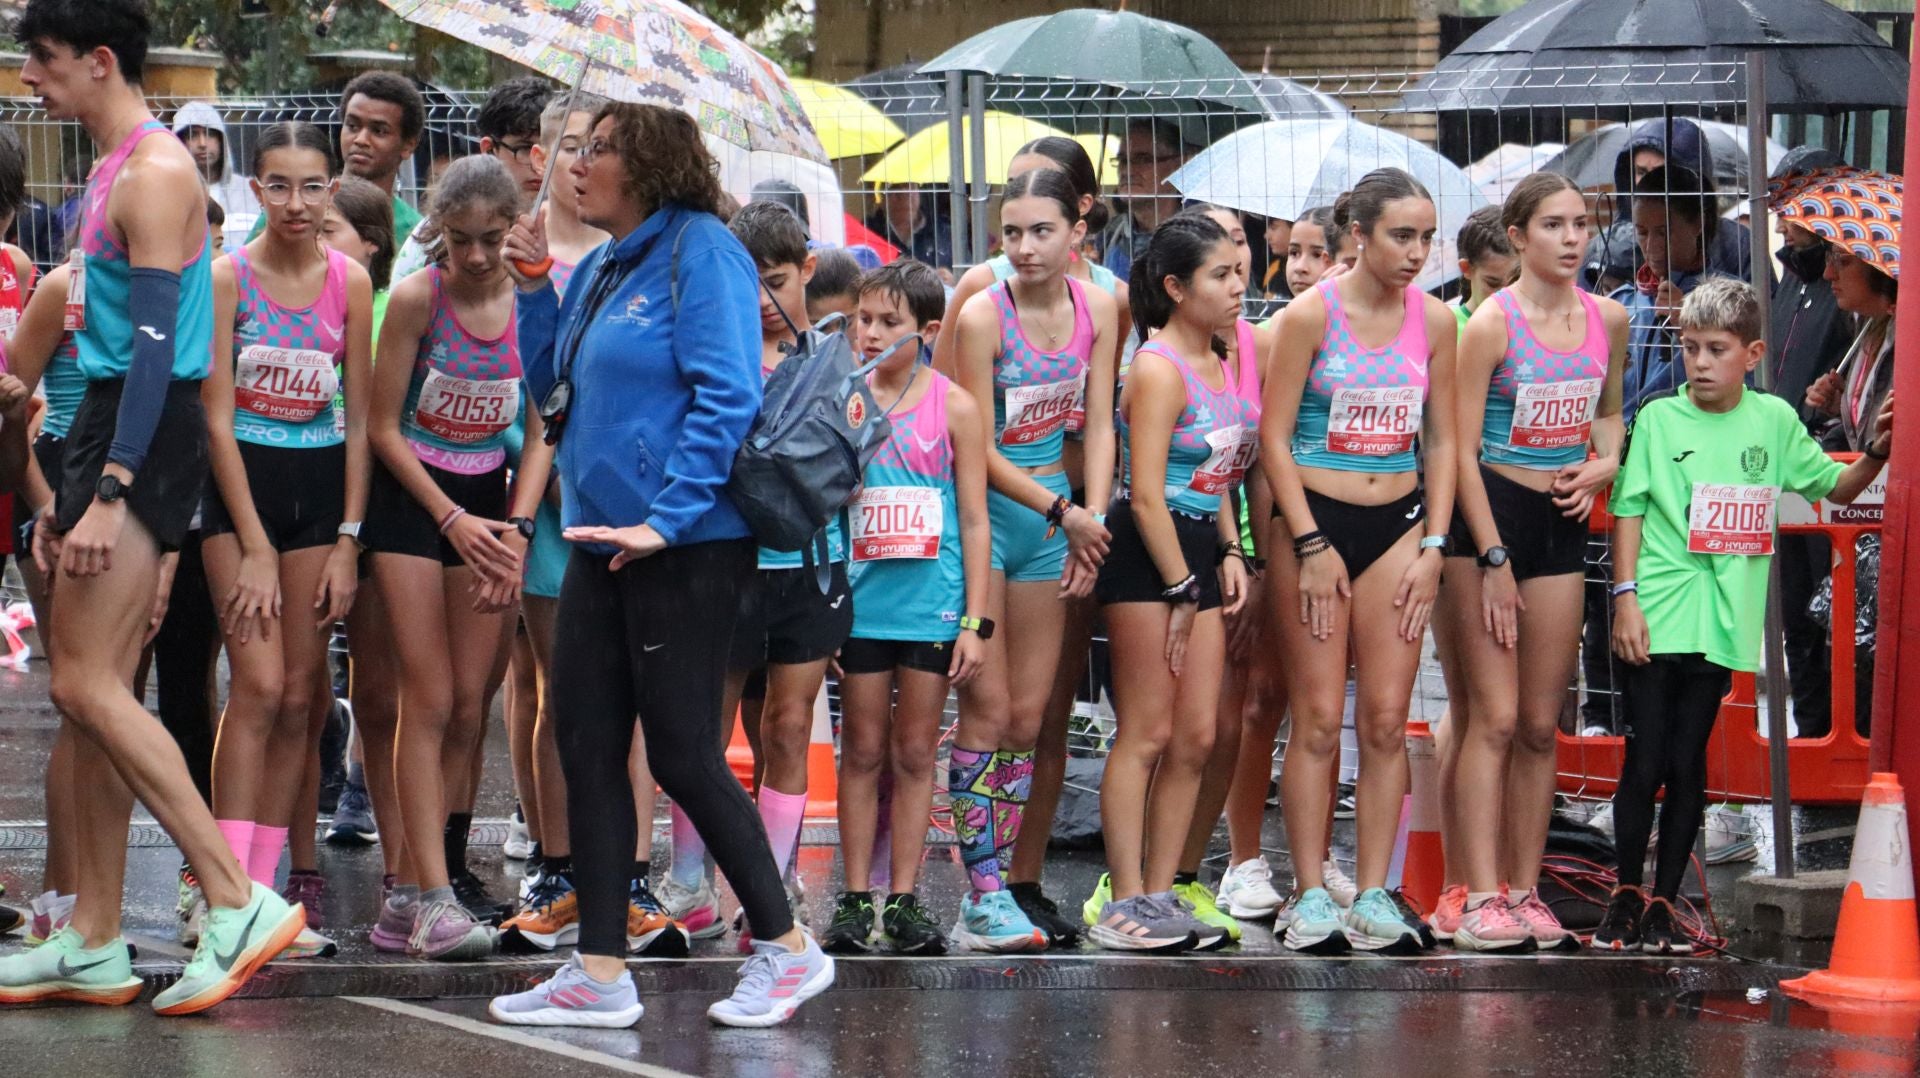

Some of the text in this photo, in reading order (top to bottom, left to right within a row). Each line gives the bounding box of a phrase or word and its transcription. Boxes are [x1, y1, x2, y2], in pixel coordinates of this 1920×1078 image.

[252, 364, 321, 399] 2044
[434, 390, 504, 423] 2053
[1018, 390, 1075, 425] 2046
[1345, 405, 1409, 432] 2048
[1529, 396, 1588, 427] 2039
[862, 504, 925, 536] 2004
[1706, 501, 1766, 531] 2008
[880, 544, 925, 554] HYUNDAI
[1725, 541, 1762, 550] HYUNDAI
